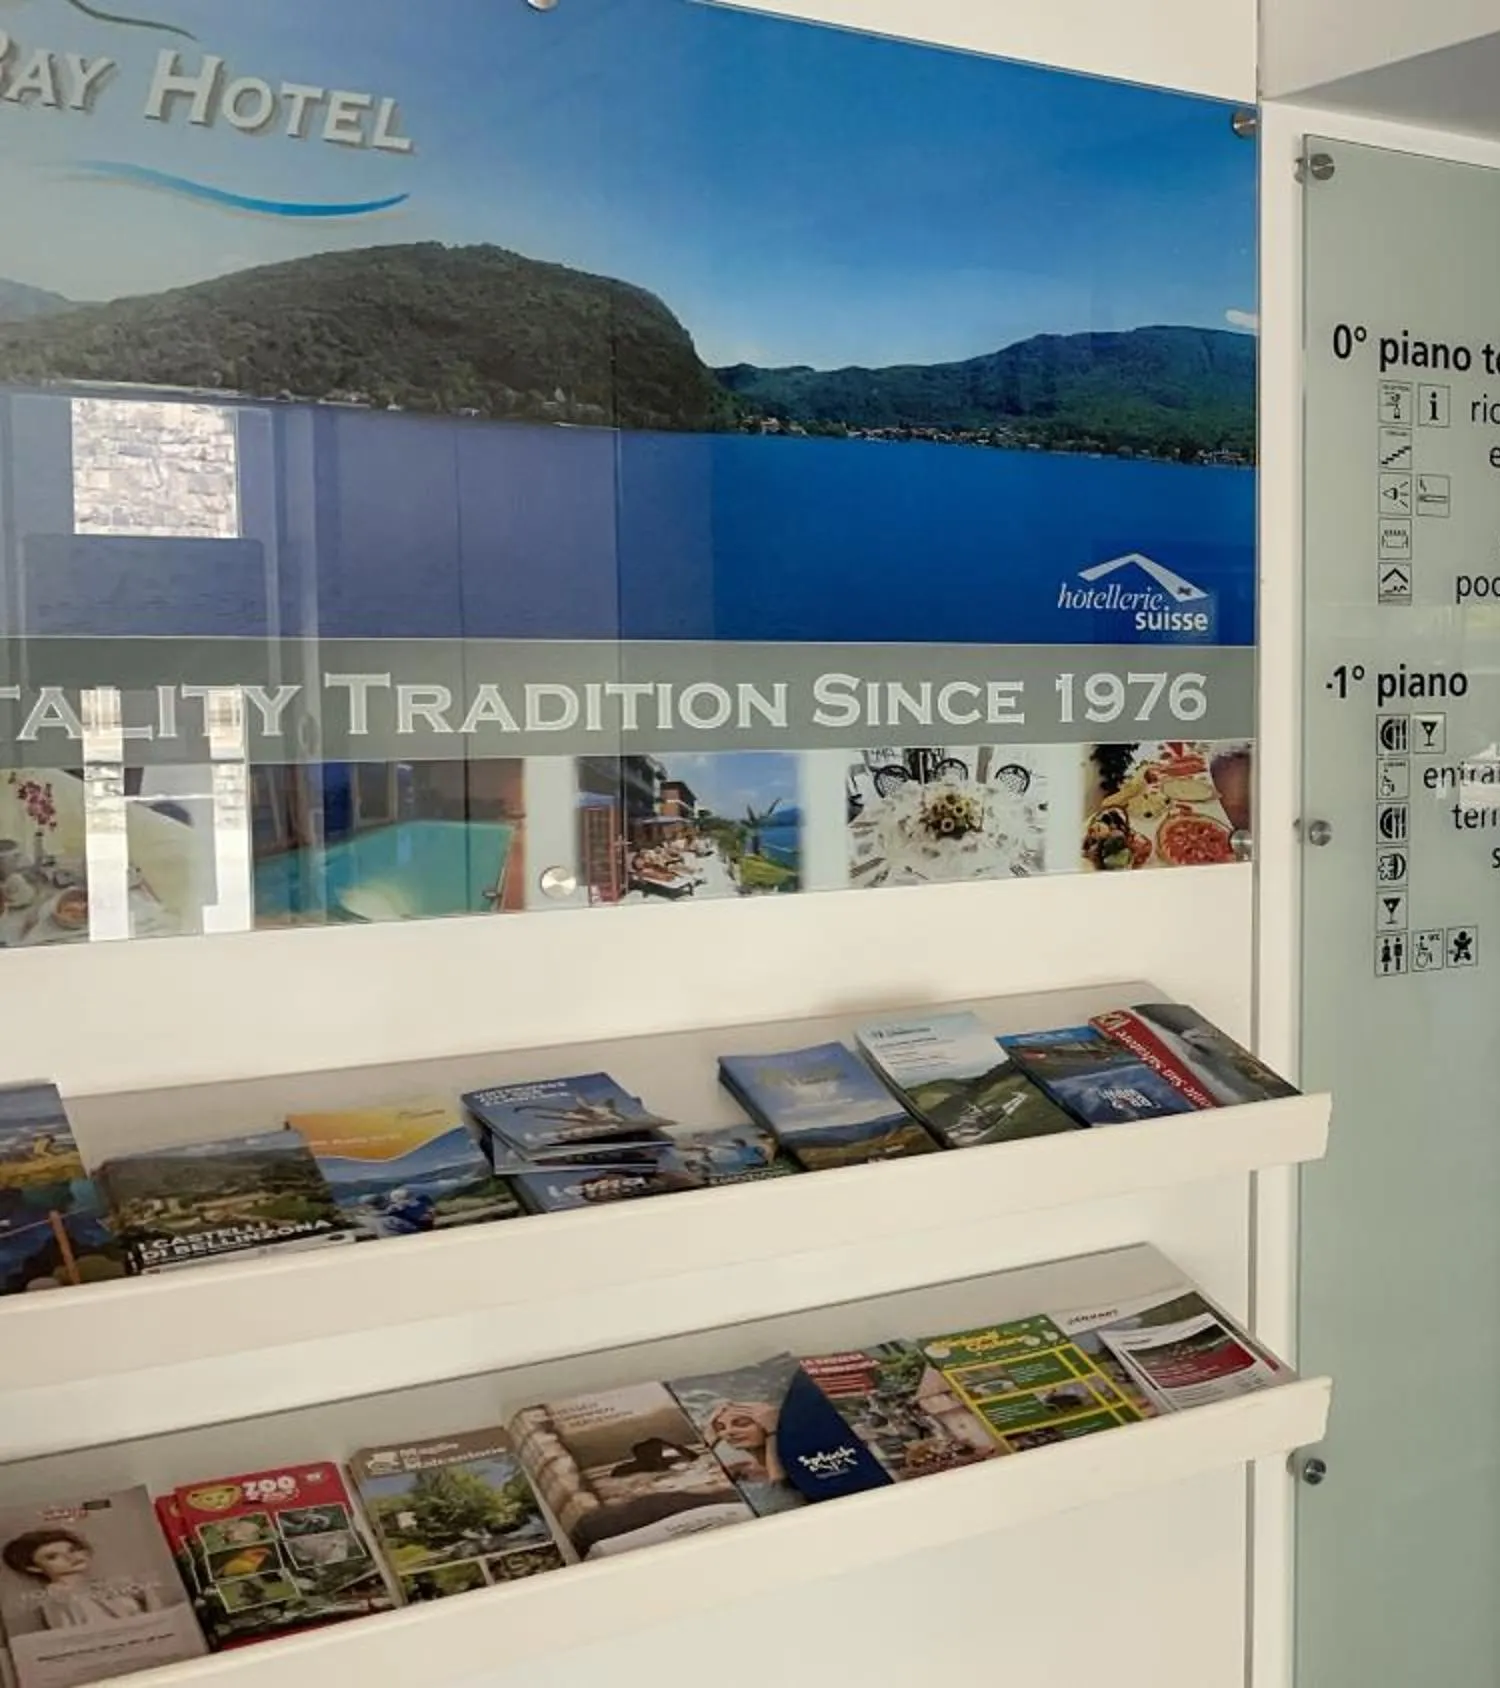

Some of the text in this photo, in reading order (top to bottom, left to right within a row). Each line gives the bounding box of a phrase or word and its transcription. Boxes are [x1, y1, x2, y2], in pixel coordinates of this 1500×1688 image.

[0, 28, 414, 152] AY HOTEL
[1379, 330, 1472, 372] piano
[1057, 581, 1162, 612] hotellerie
[1135, 606, 1209, 631] suisse
[325, 672, 789, 735] TRADITION
[812, 672, 1025, 728] SINCE
[1055, 671, 1208, 723] 1976
[1377, 663, 1468, 707] piano
